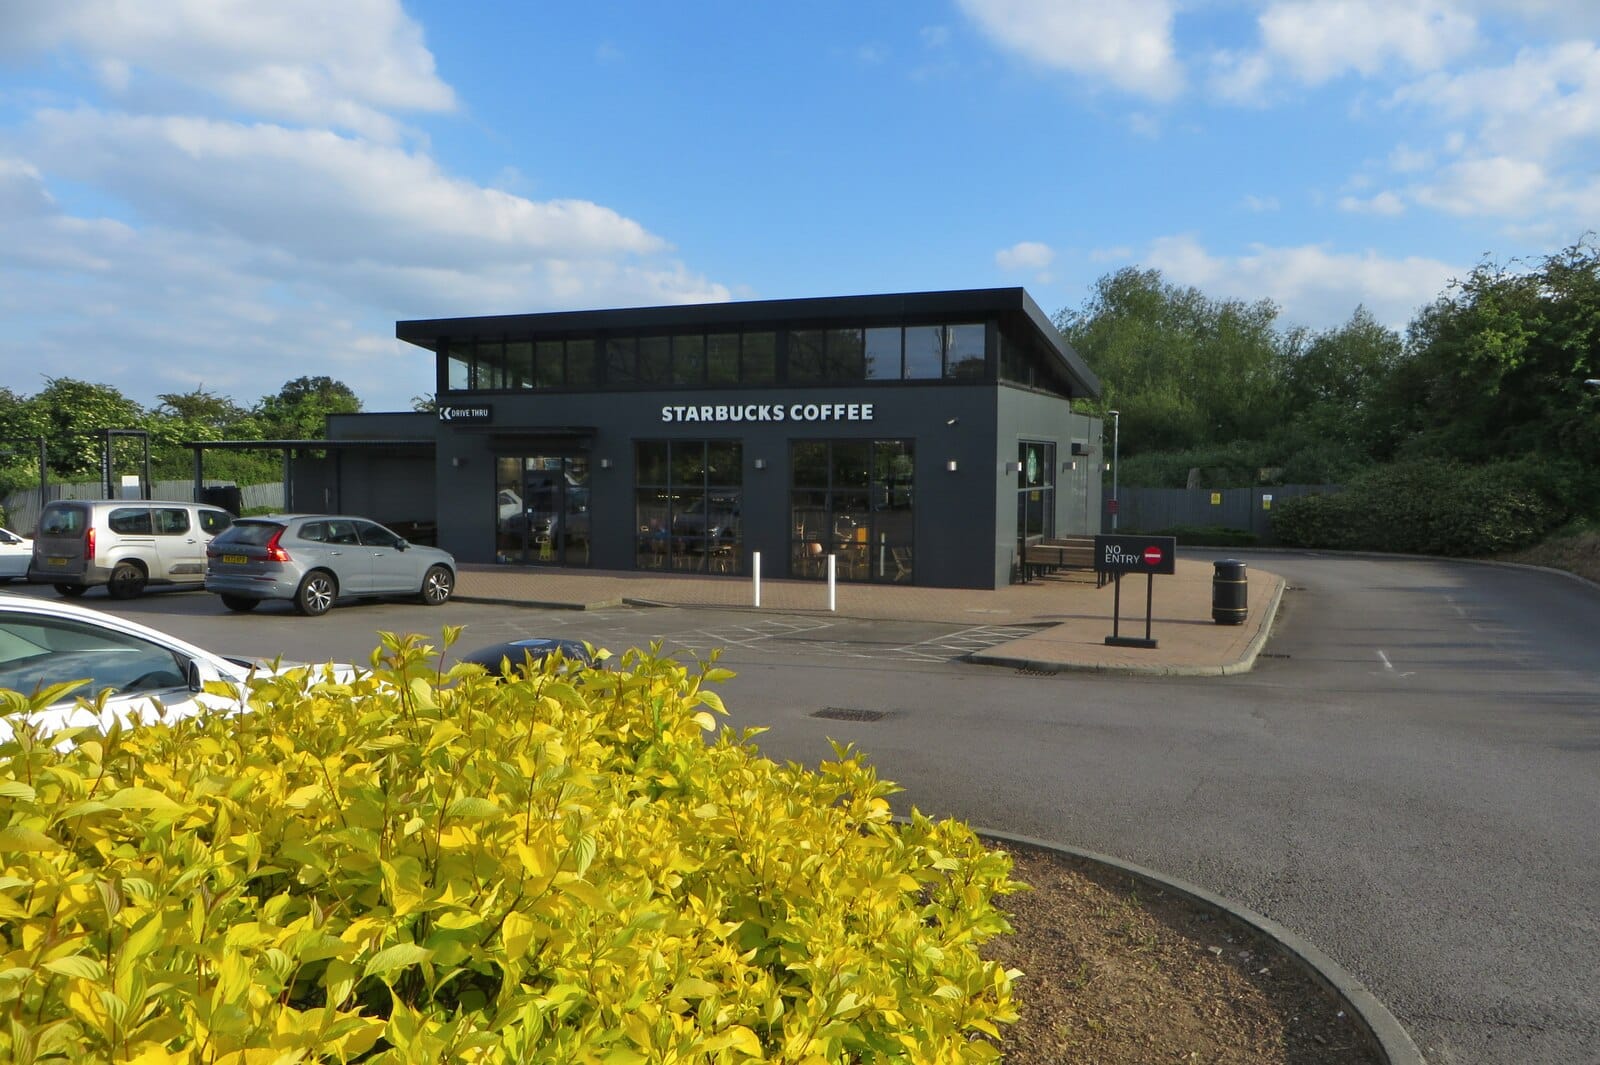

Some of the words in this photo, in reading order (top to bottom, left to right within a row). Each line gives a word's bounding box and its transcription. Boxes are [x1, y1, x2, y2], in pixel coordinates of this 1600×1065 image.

[451, 409, 470, 417] DRIVE
[471, 409, 488, 417] THRU
[662, 405, 785, 422] STARBUCKS
[790, 403, 873, 421] COFFEE
[1105, 544, 1121, 554] NO
[1105, 554, 1140, 564] ENTRY
